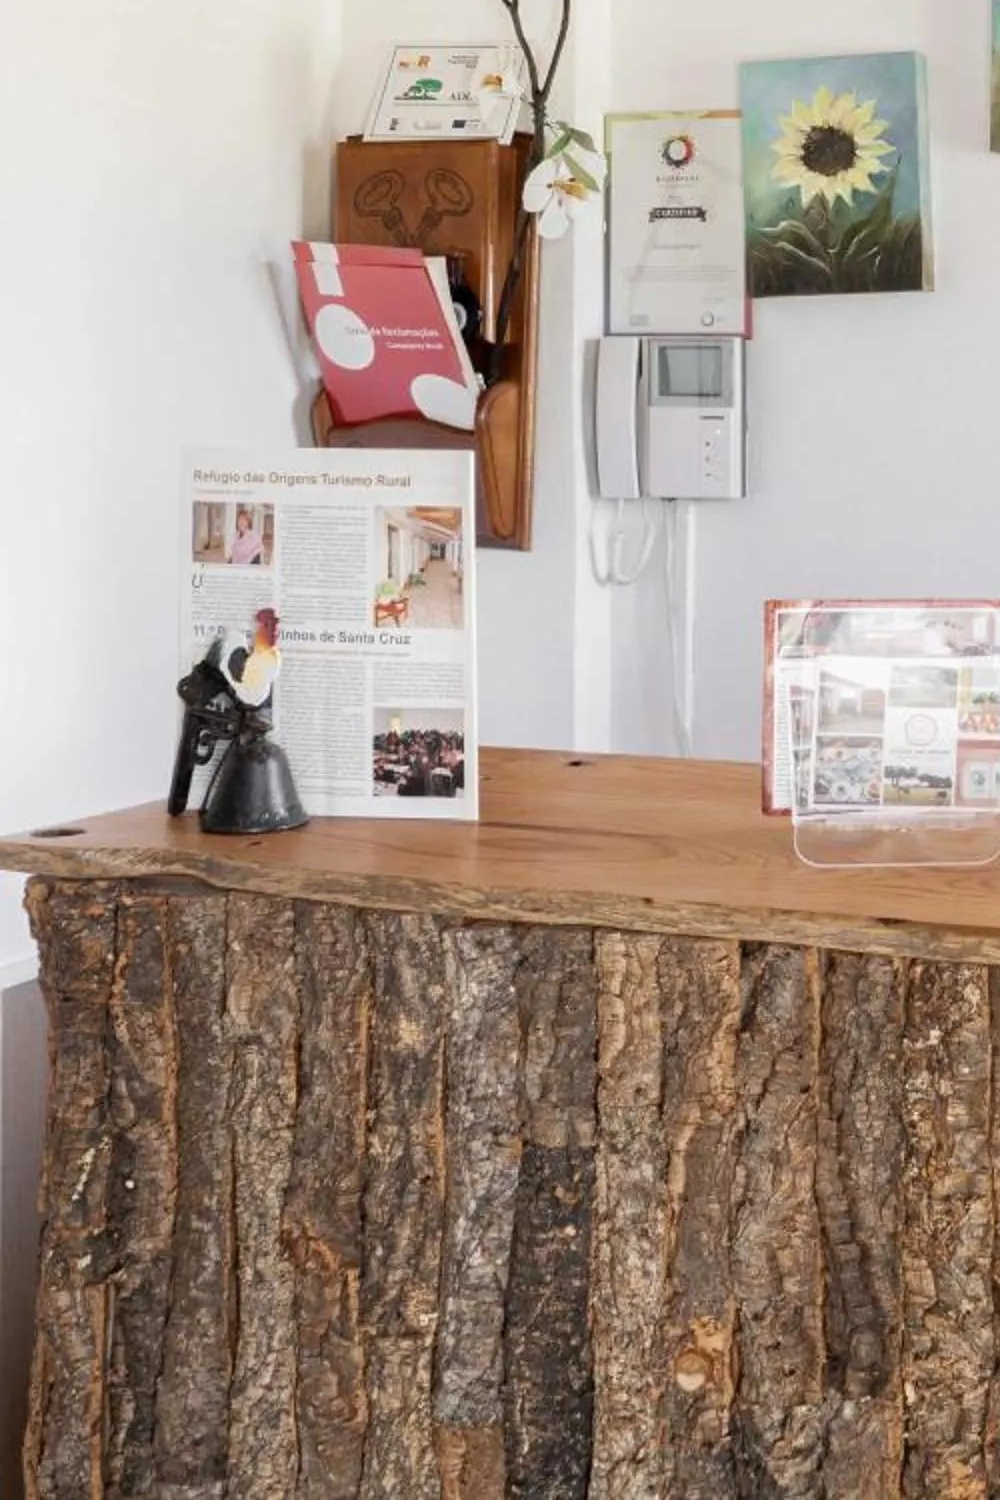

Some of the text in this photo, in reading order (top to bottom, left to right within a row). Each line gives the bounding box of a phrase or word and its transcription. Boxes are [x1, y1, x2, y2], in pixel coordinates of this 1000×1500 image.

[269, 471, 318, 486] Origens
[321, 472, 372, 486] Turismo
[376, 473, 411, 487] Rural
[279, 629, 412, 645] inhos de Santa Cruz
